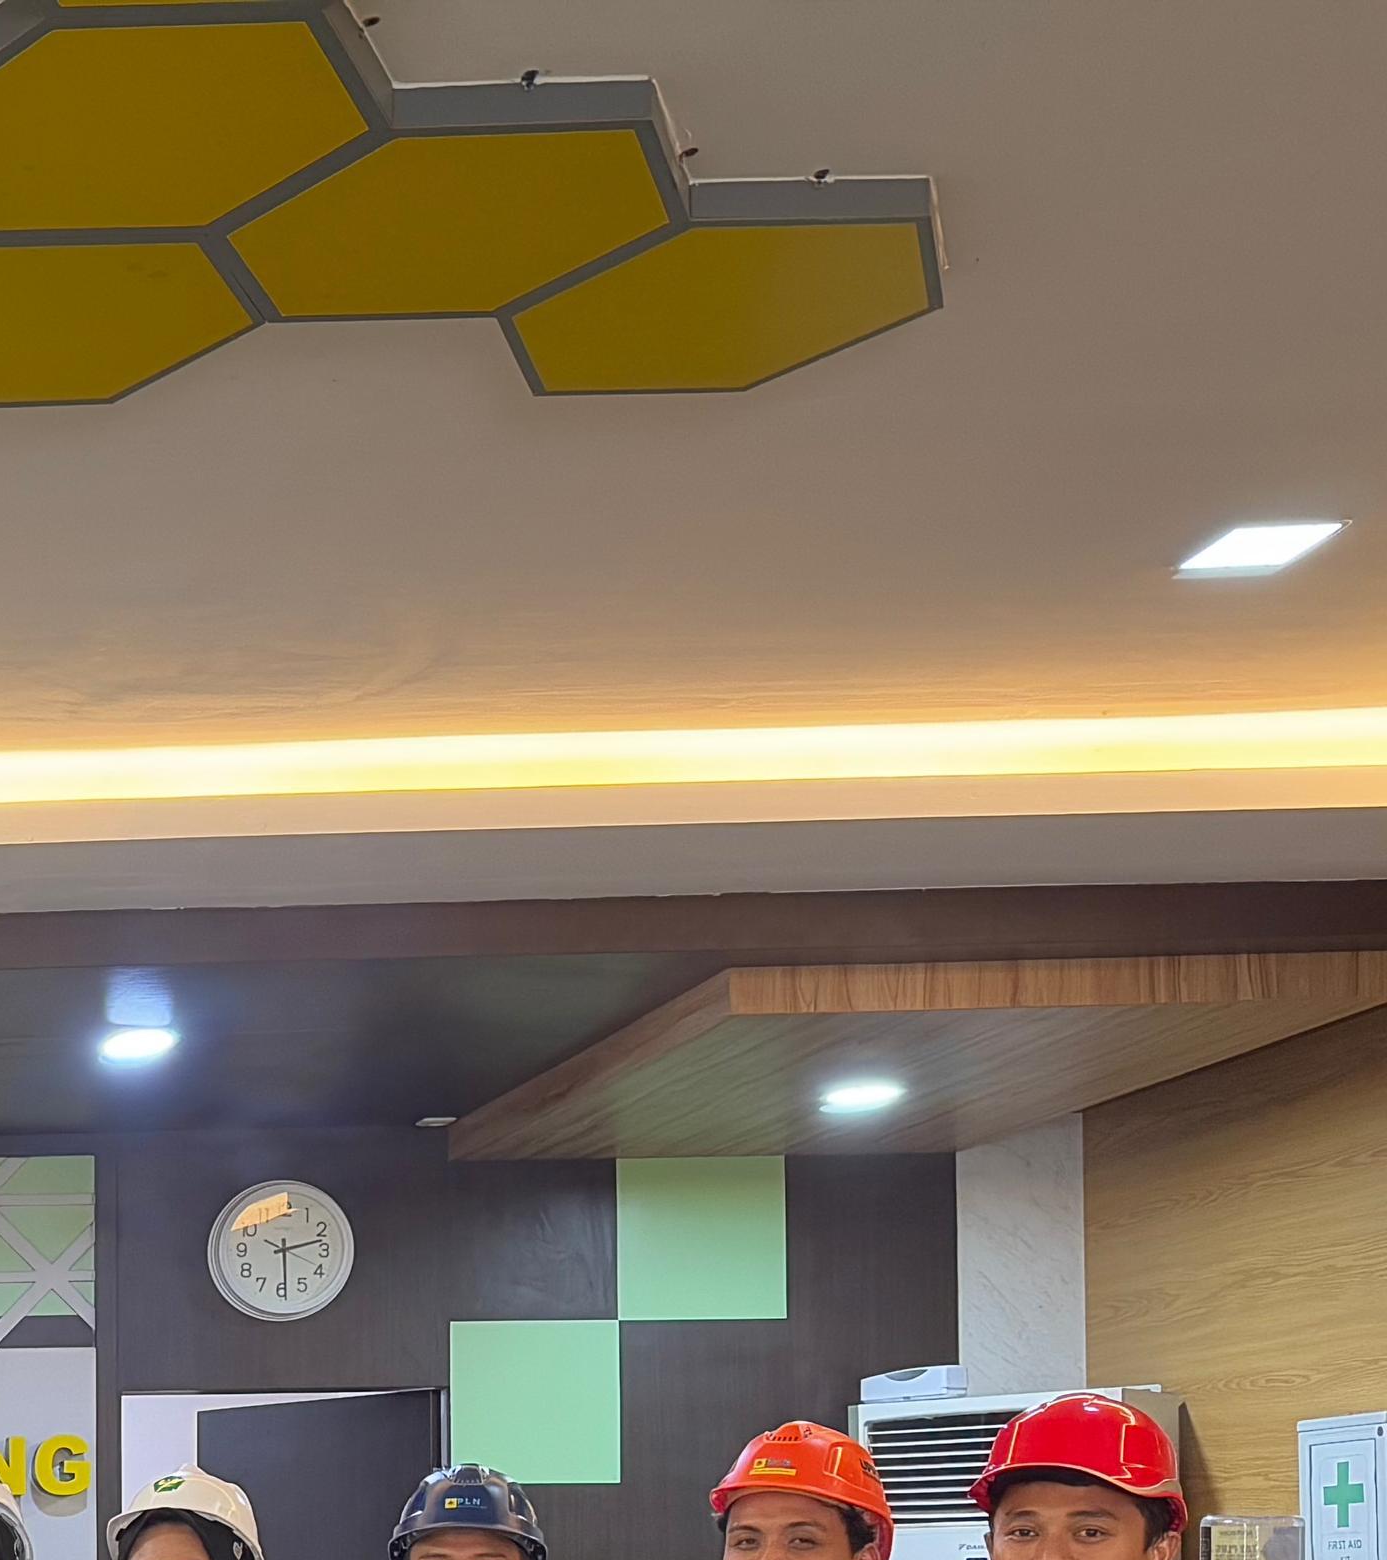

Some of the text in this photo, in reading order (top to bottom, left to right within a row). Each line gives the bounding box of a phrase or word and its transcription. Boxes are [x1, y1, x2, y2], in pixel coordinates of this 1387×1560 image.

[316, 1222, 328, 1238] 2
[236, 1242, 247, 1258] 9
[318, 1242, 330, 1259] 3
[240, 1262, 252, 1278] 8
[313, 1263, 325, 1279] 4
[255, 1277, 267, 1293] 7
[276, 1282, 287, 1298] 6
[296, 1277, 308, 1293] 5
[457, 1497, 481, 1506] PLN
[1328, 1539, 1362, 1550] FIRST AID
